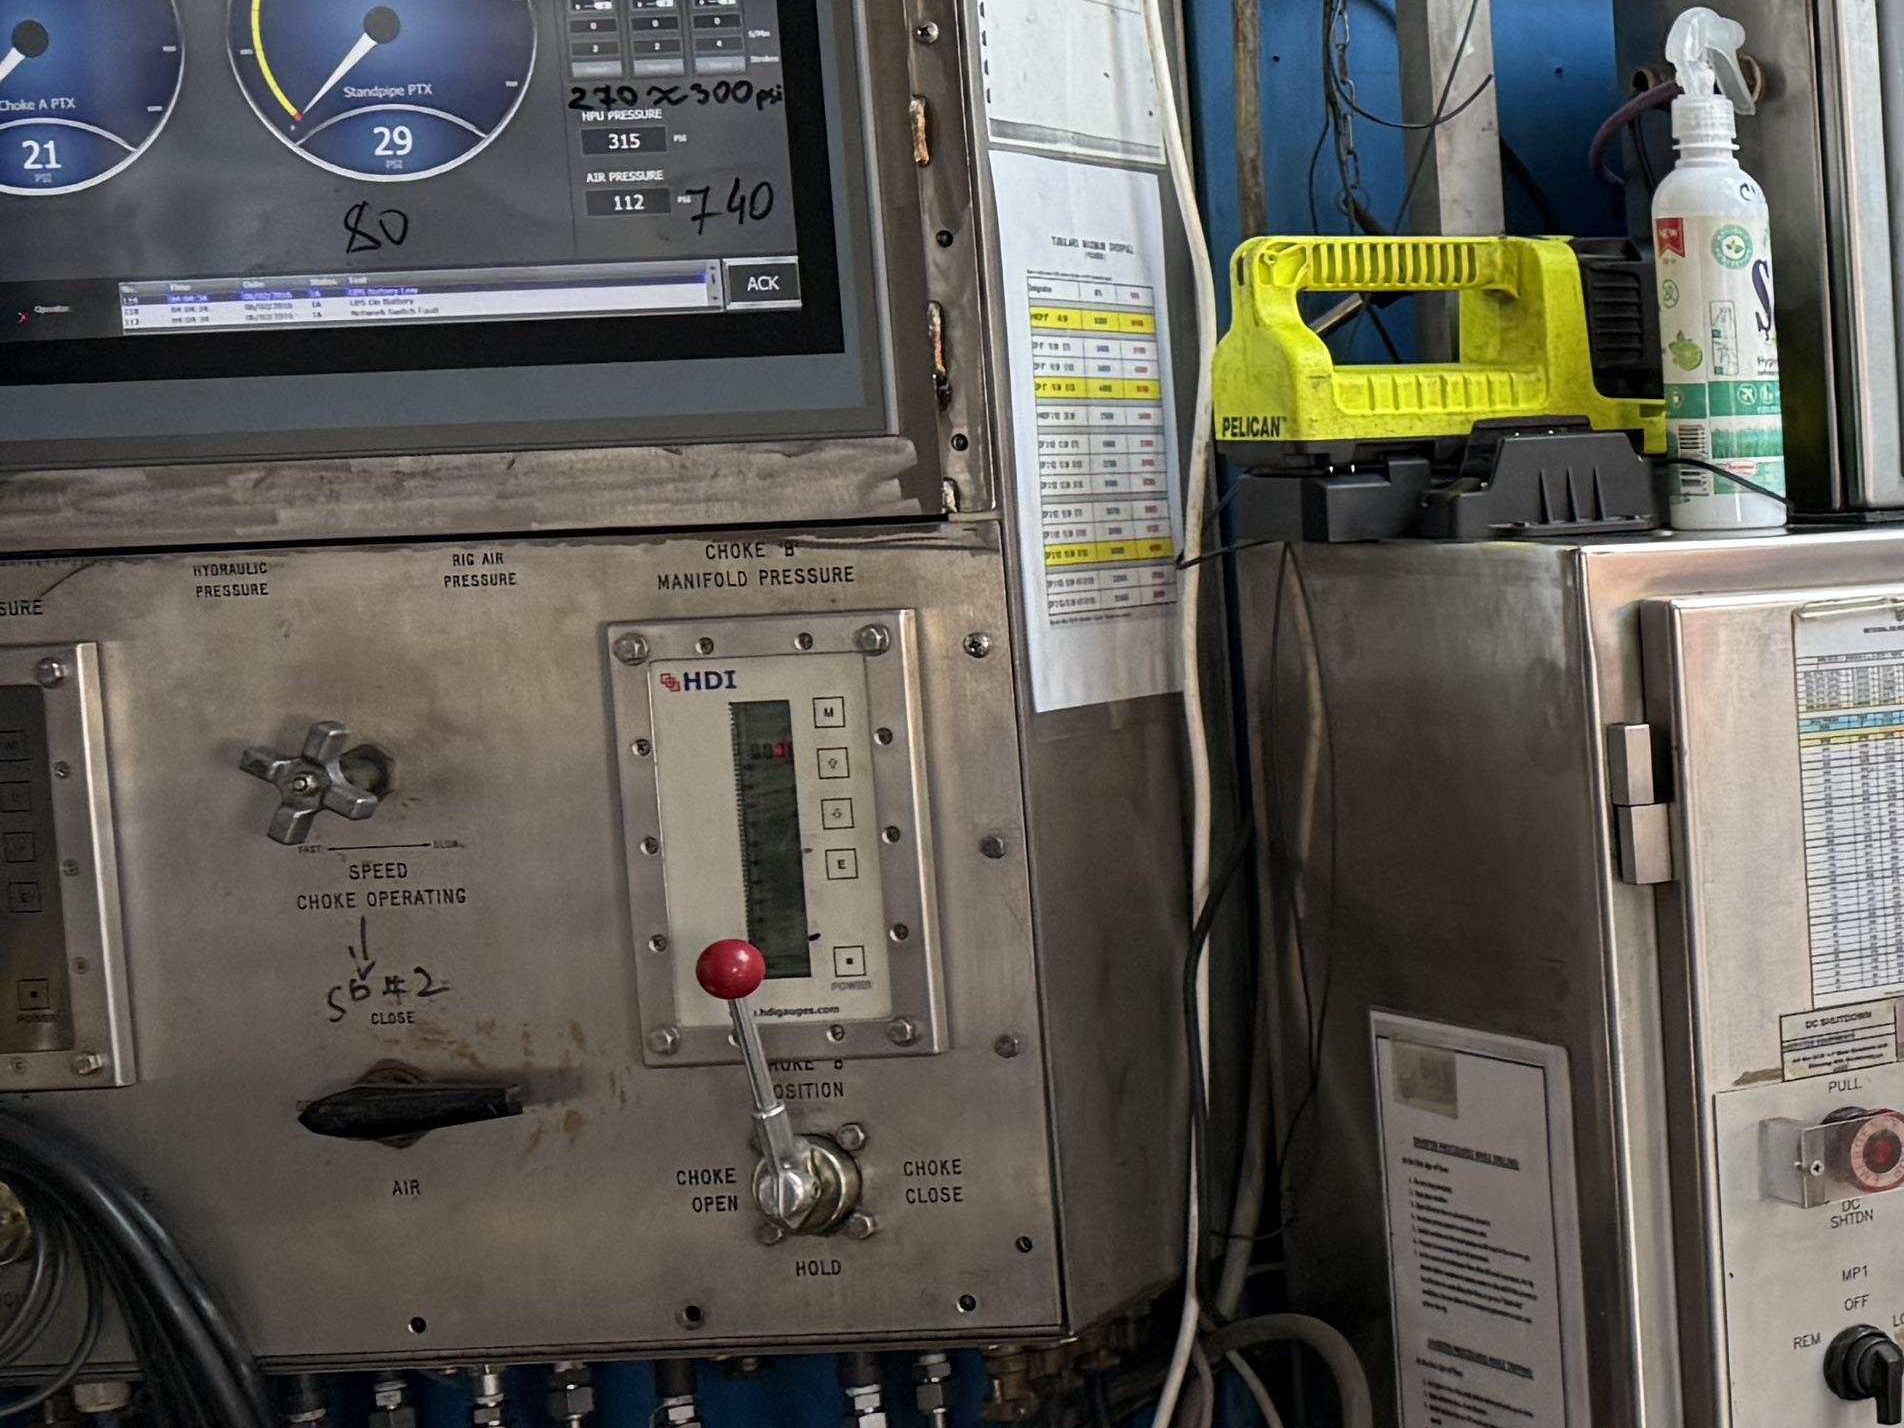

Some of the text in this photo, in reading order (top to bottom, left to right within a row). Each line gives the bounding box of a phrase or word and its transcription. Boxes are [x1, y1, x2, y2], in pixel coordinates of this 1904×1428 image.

[343, 83, 433, 101] Standpipe PTX
[607, 108, 663, 121] PRESSURE
[372, 125, 414, 157] 29
[608, 133, 640, 149] 315
[21, 139, 62, 170] 21
[586, 170, 665, 183] AIR PRESSURE
[614, 195, 645, 211] 112
[685, 177, 774, 236] 740
[747, 276, 780, 291] ACK
[1221, 417, 1281, 439] PELICAN
[452, 552, 504, 567] RIG AIR
[705, 542, 766, 560] CHOKE
[193, 562, 268, 577] HYDRAULIC
[658, 566, 855, 590] MANIFOLD PRESSURE
[444, 573, 517, 588] PRESSURE
[196, 583, 269, 598] PRESSURE
[683, 670, 737, 691] HDI
[348, 862, 408, 880] SPEED
[297, 888, 467, 911] CHOKE OPERATING
[371, 1011, 416, 1025] CLOSE
[1828, 1078, 1862, 1093] PULL
[903, 1159, 963, 1177] CHOKE
[676, 1168, 737, 1186] CHOKE
[392, 1180, 421, 1196] AIR
[905, 1186, 963, 1204] CLOSE
[692, 1195, 739, 1213] OPEN
[1830, 1209, 1873, 1228] SHTDN
[796, 1260, 842, 1277] HOLD
[1842, 1266, 1868, 1281] MP1
[1844, 1295, 1870, 1310] OFF
[1793, 1333, 1821, 1349] REM
